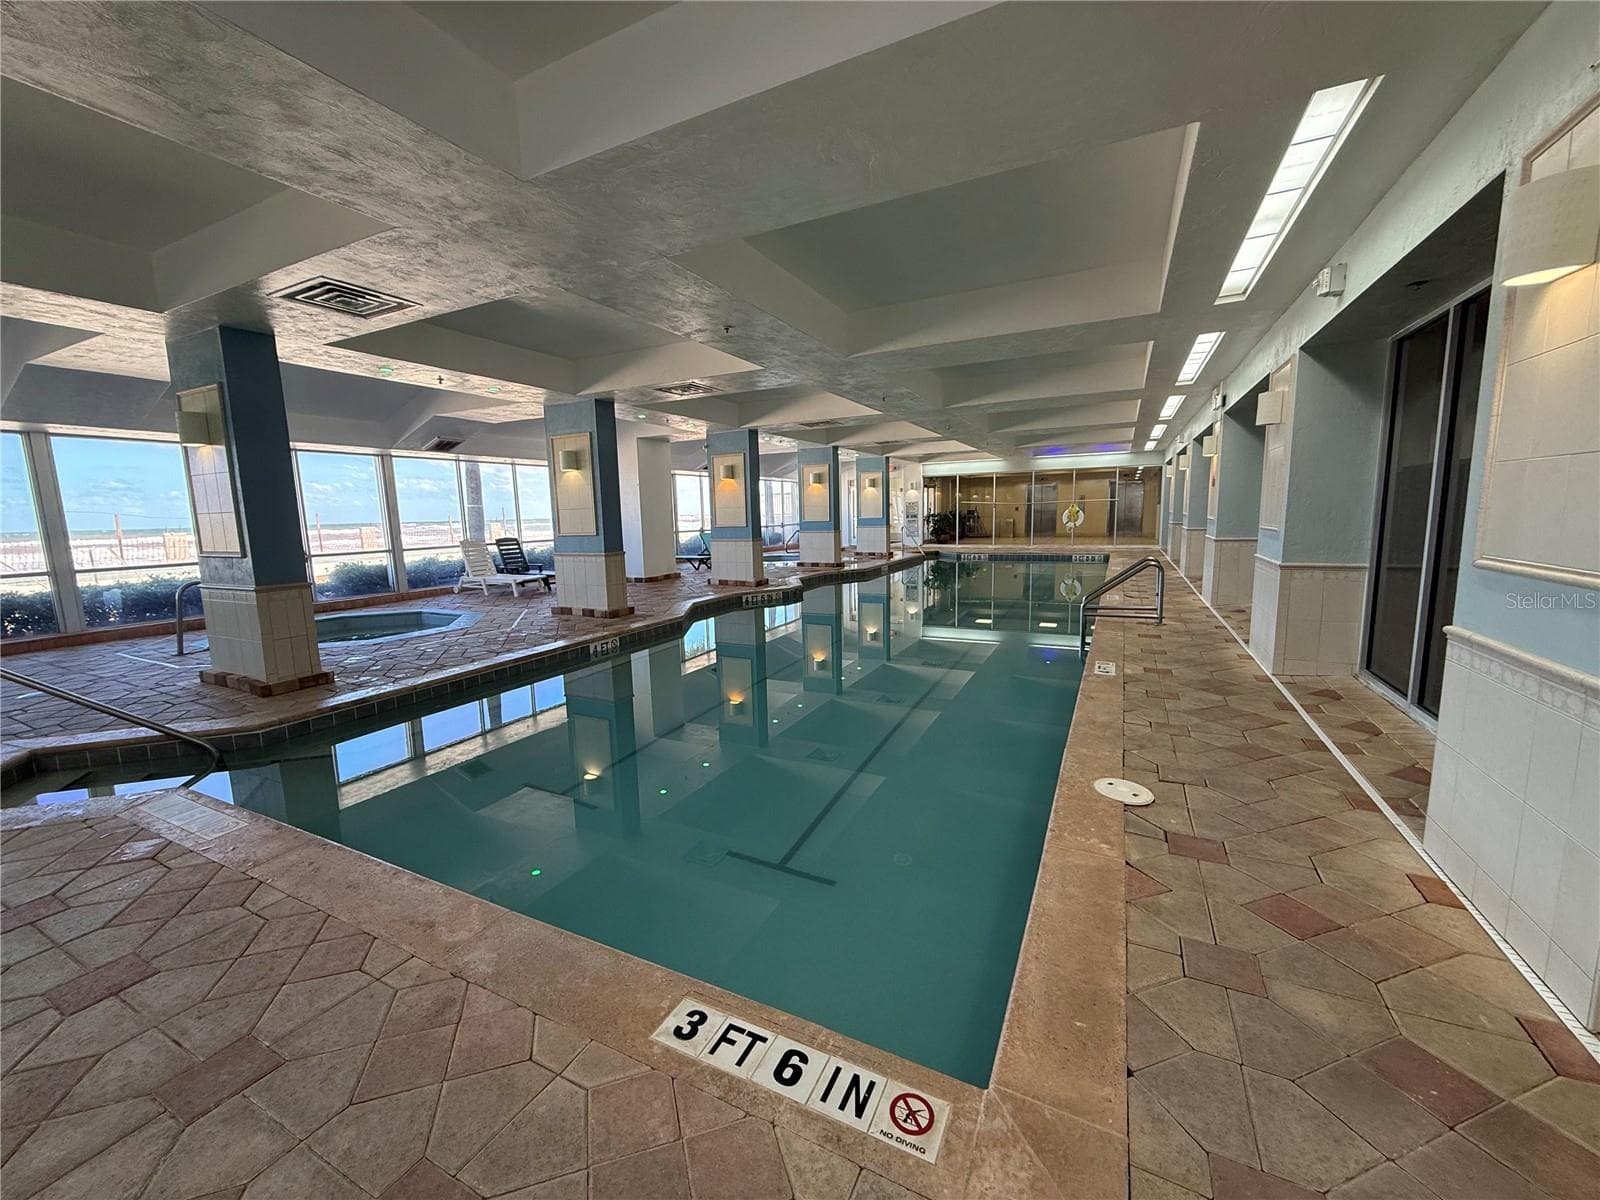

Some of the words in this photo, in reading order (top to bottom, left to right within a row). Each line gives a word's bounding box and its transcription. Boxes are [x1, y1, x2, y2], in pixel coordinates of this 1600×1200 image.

[672, 1009, 708, 1042] 3
[708, 1023, 768, 1068] FT
[772, 1048, 809, 1087] 6
[819, 1065, 876, 1120] IN
[879, 1129, 894, 1140] NO
[895, 1136, 926, 1155] DIVING
